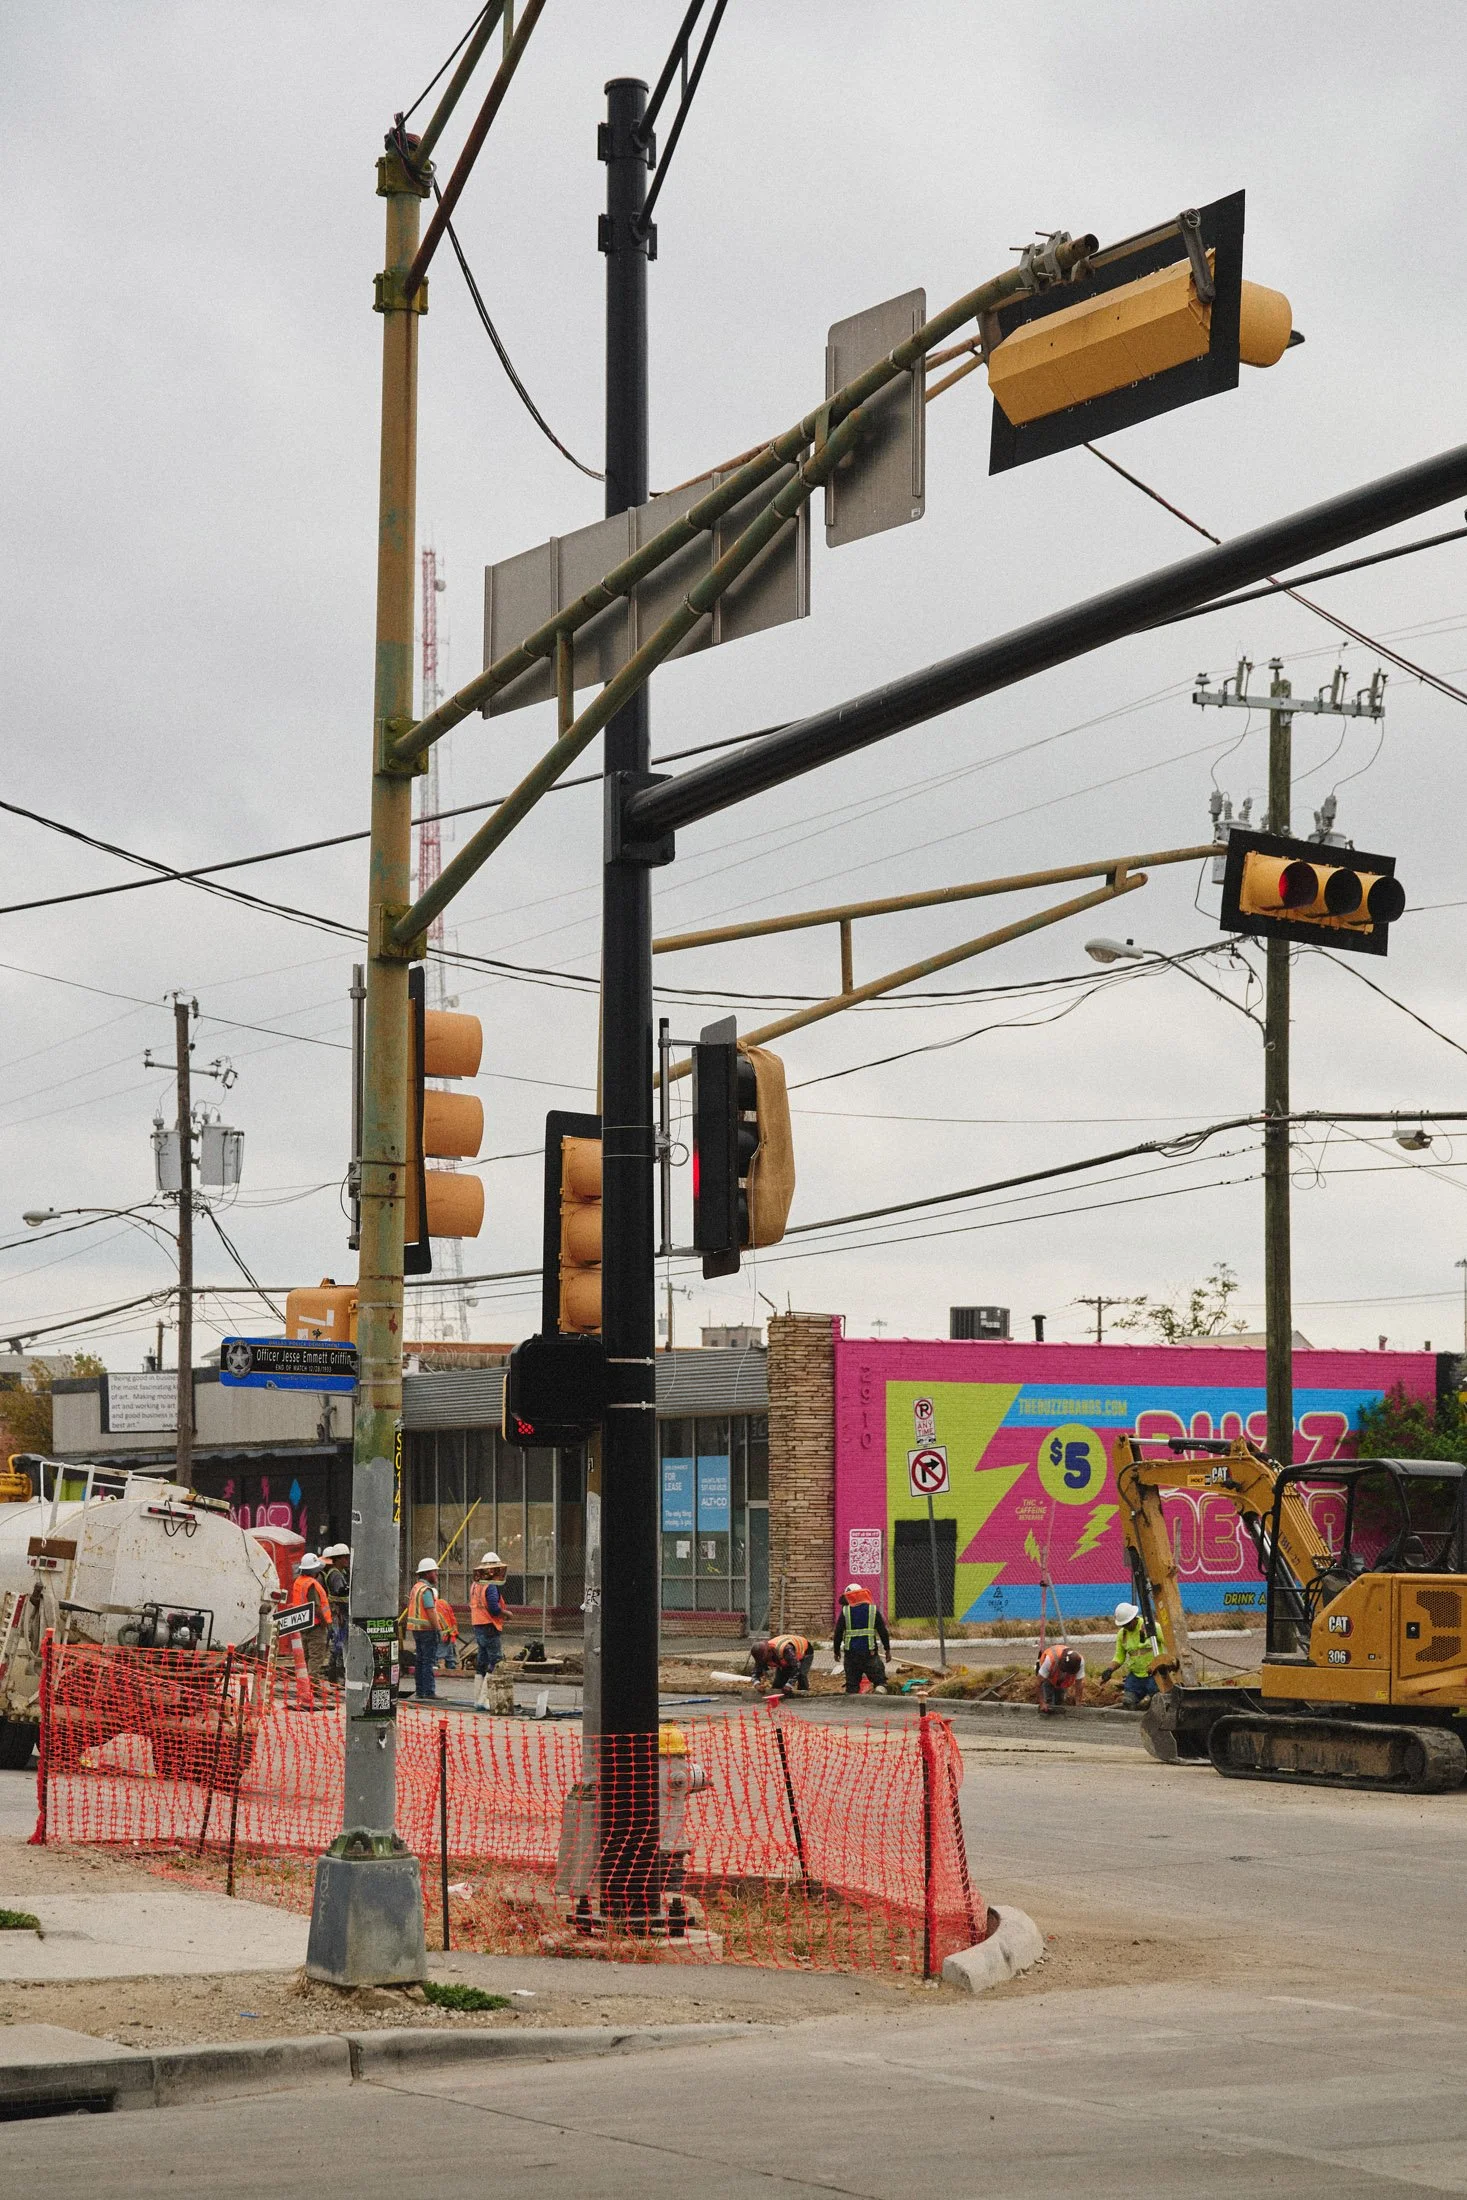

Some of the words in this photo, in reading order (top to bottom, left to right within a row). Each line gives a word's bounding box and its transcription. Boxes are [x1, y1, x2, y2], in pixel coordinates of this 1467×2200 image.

[256, 1349, 279, 1362] Officer
[282, 1350, 301, 1363] Jesse
[303, 1351, 328, 1364] Emmett
[331, 1352, 351, 1365] Griffin
[917, 1420, 933, 1429] ANY
[1050, 1437, 1091, 1489] $5
[665, 1472, 676, 1481] FOR
[1211, 1466, 1228, 1483] CAT
[665, 1482, 682, 1491] LEASE
[1015, 1506, 1048, 1514] CAFFEINE
[1223, 1592, 1256, 1605] DRINK
[278, 1617, 288, 1629] NE
[290, 1611, 308, 1625] WAY
[366, 1619, 394, 1628] RBC
[1328, 1615, 1351, 1633] CAT
[1328, 1650, 1347, 1665] 306
